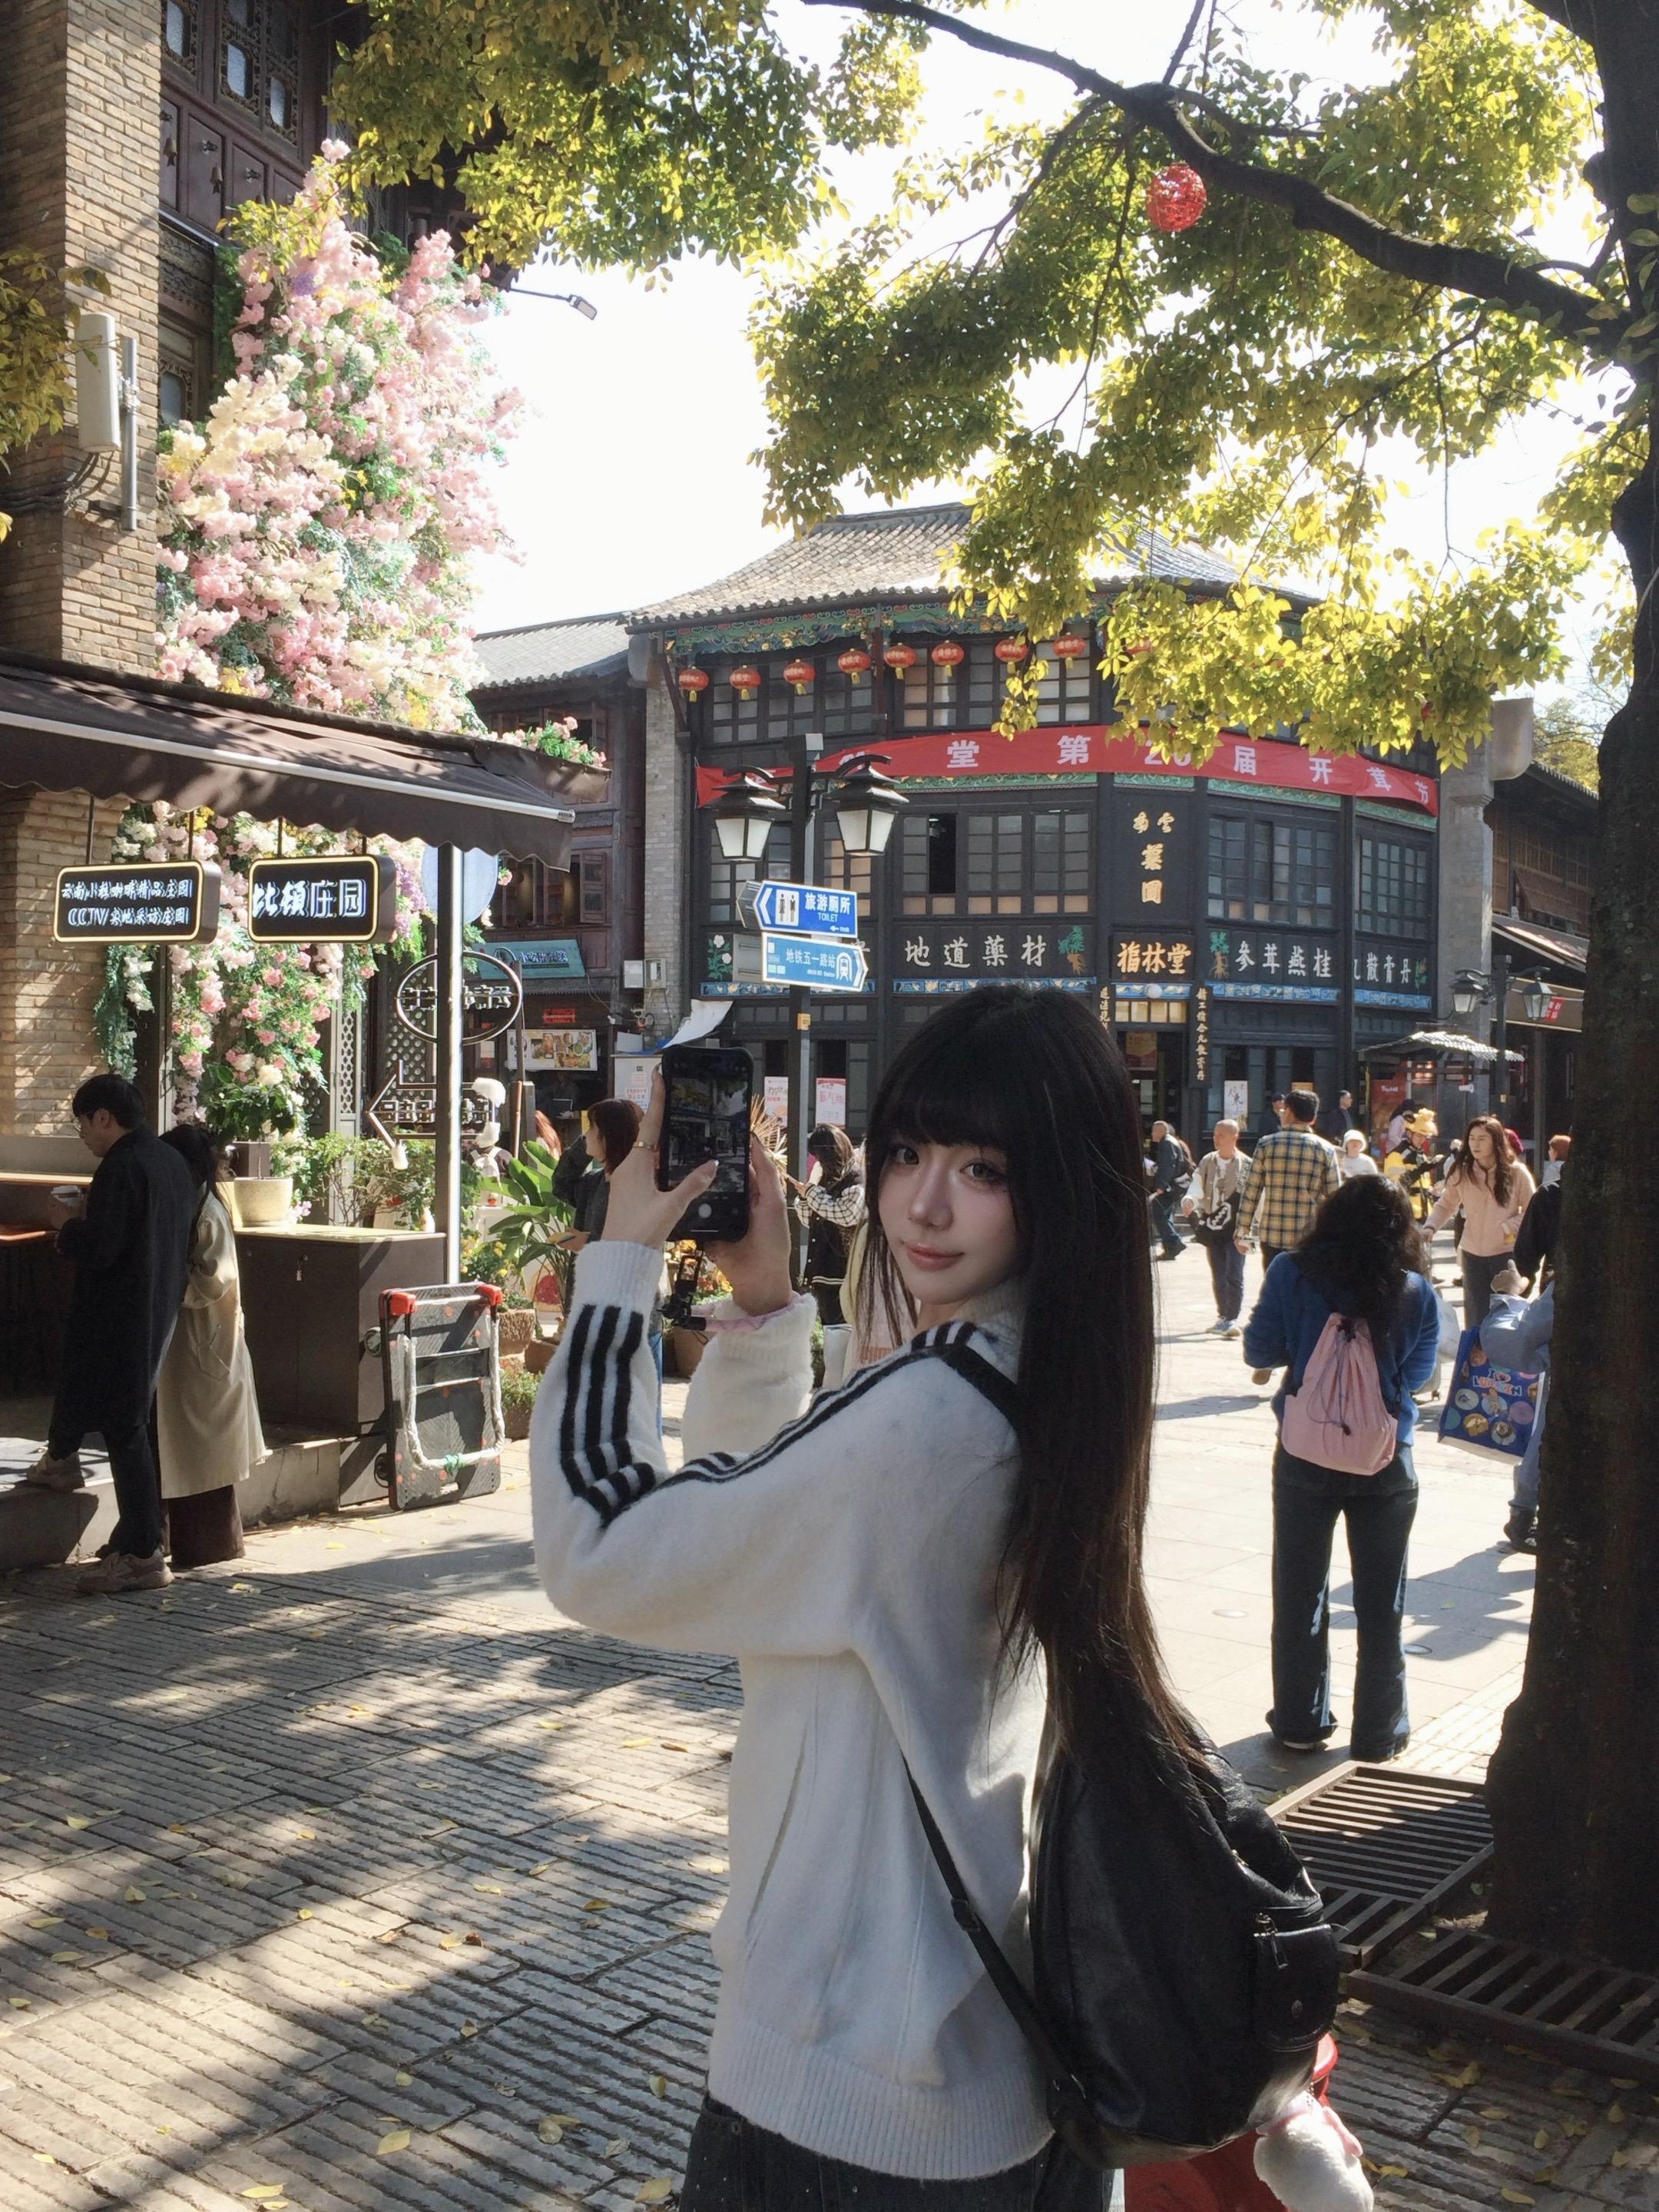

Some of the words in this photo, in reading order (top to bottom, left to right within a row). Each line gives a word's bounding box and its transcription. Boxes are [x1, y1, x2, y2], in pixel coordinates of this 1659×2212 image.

[749, 735, 1429, 805] 堂第20届开茸节
[818, 912, 839, 923] TOILET
[786, 948, 836, 968] 地铁五一路站
[904, 933, 1048, 969] 地道藥材
[1117, 941, 1191, 975] 福林堂
